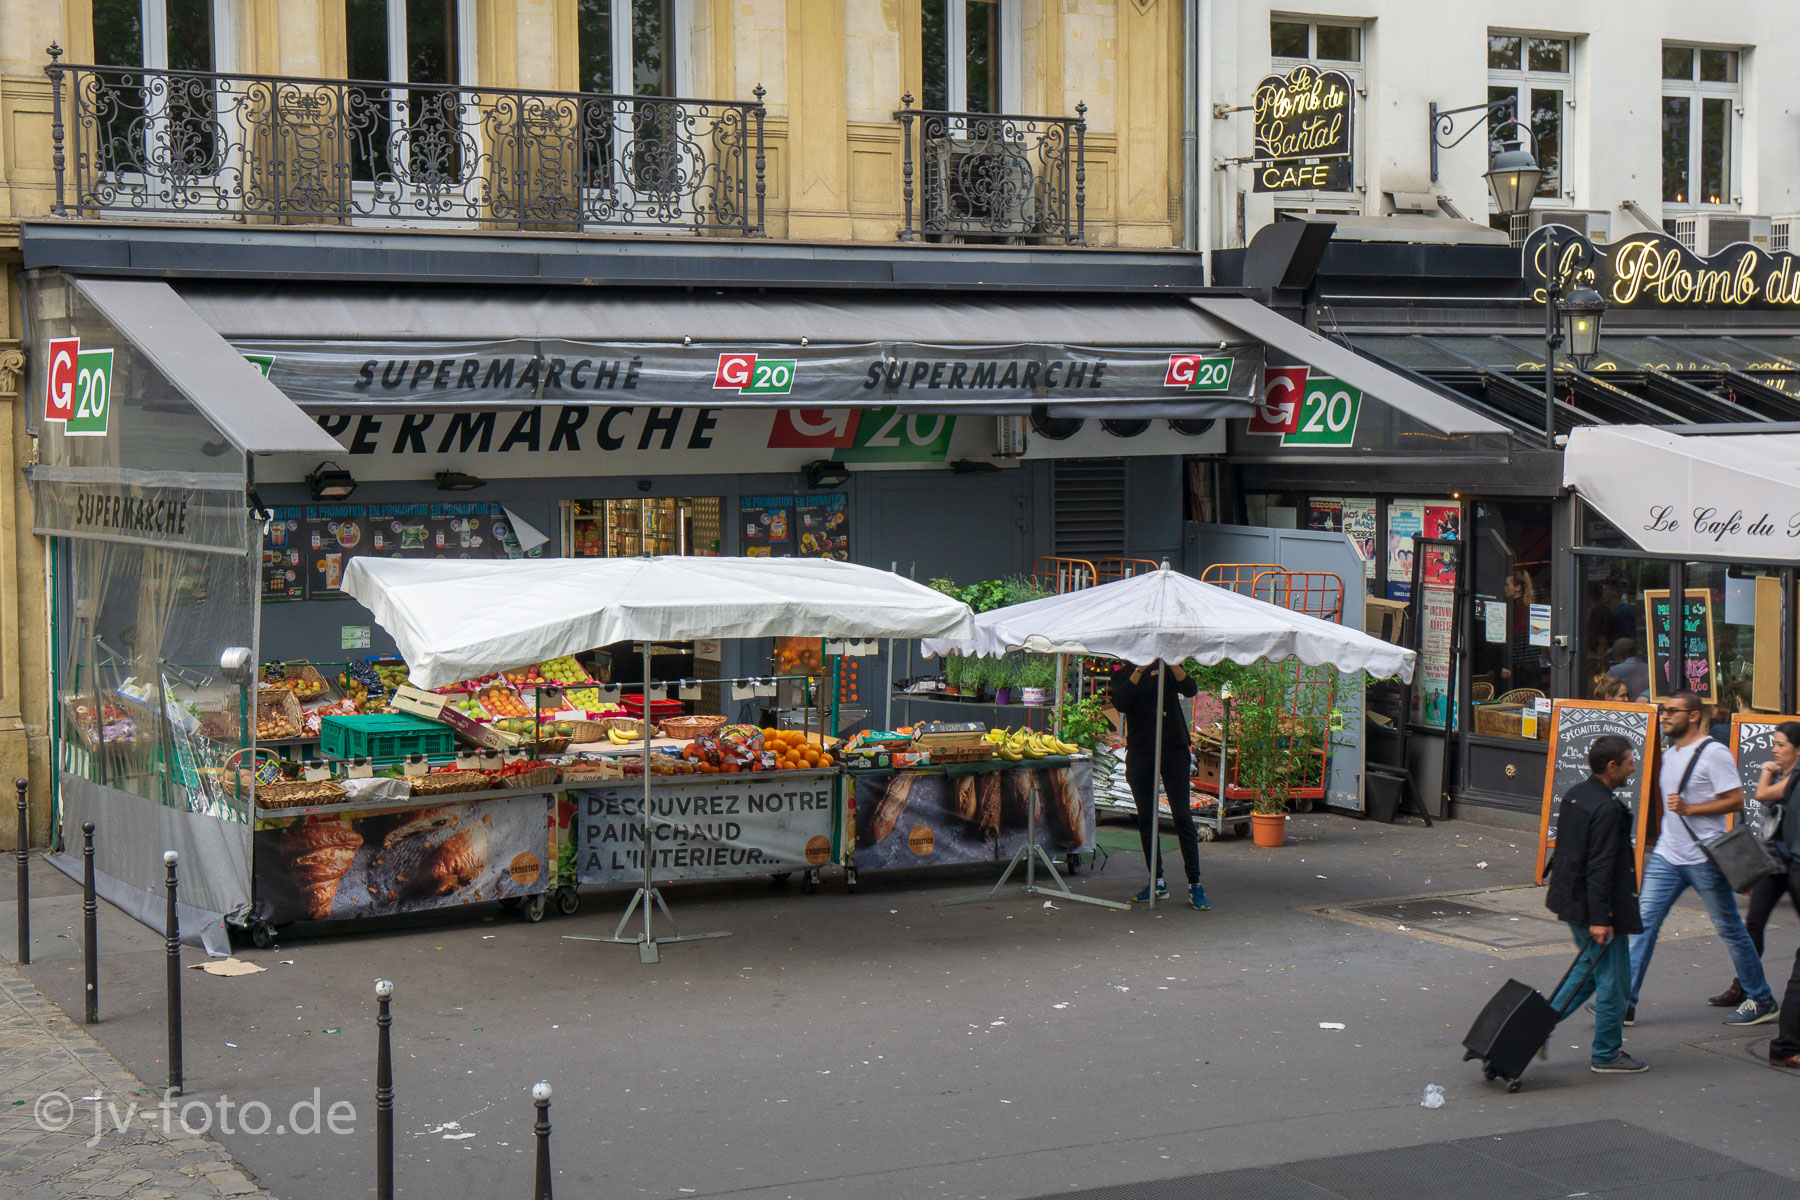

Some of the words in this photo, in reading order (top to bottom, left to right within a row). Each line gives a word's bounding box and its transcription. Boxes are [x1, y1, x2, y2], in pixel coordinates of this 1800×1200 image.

[1289, 67, 1311, 93] Le
[1253, 79, 1322, 124] Plomb
[1323, 85, 1344, 110] du
[1261, 113, 1342, 156] Cantal
[1262, 166, 1330, 188] CAFE
[1613, 240, 1760, 304] Plomb
[354, 355, 644, 392] SUPERMARCHÉ
[319, 505, 366, 517] PROMOTION
[381, 504, 428, 516] PROMOTION
[443, 503, 488, 515] PROMOTION
[753, 496, 793, 508] PROMOTION
[806, 494, 846, 506] PROMOTION
[77, 494, 187, 534] SUPERMARCHÉ
[1643, 505, 1679, 532] Le
[1693, 507, 1742, 542] Café
[1747, 513, 1775, 537] du
[1603, 723, 1644, 746] AUVERGNATES
[587, 791, 740, 816] DÉCOUVREZ
[747, 790, 829, 813] NOTRE
[587, 823, 645, 843] PAIN
[654, 822, 741, 842] CHAUD
[511, 864, 539, 874] CROUSTICO
